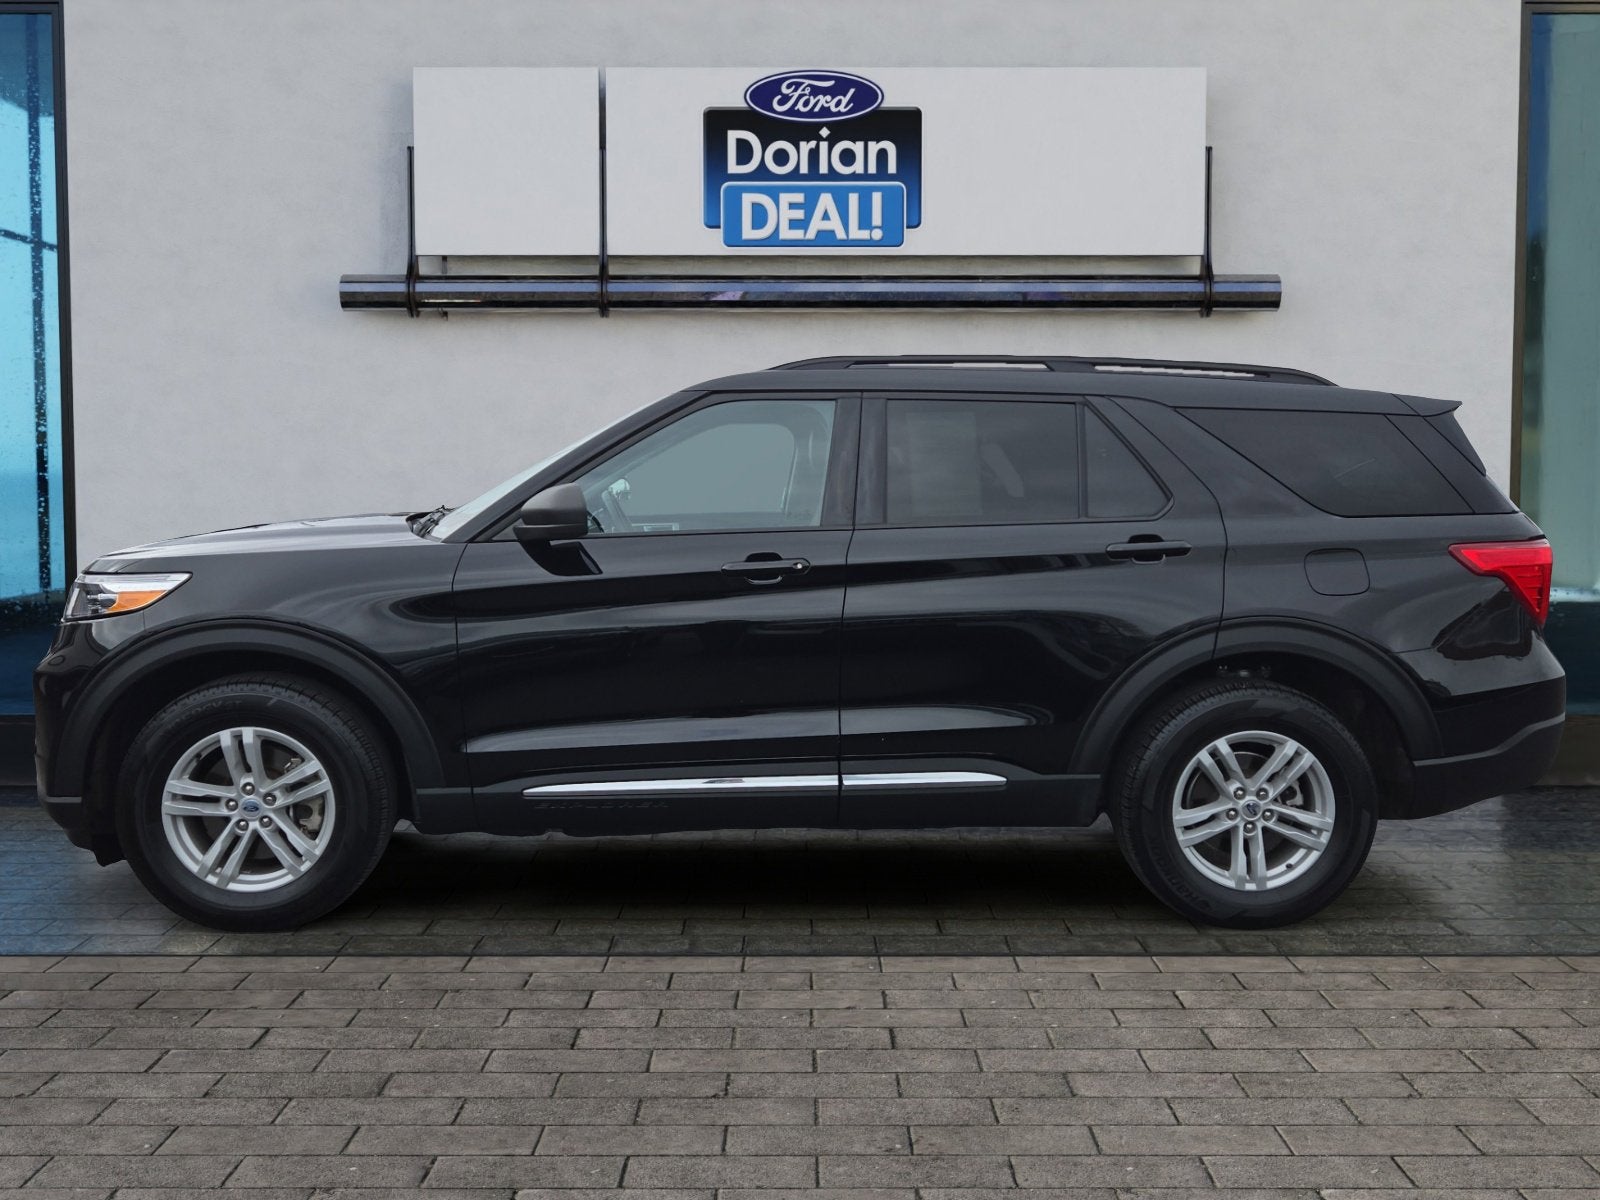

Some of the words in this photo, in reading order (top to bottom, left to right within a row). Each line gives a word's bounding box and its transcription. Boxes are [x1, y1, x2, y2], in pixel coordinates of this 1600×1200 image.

[772, 78, 856, 113] Ford
[727, 126, 897, 175] Dorian
[741, 191, 884, 241] DEAL!
